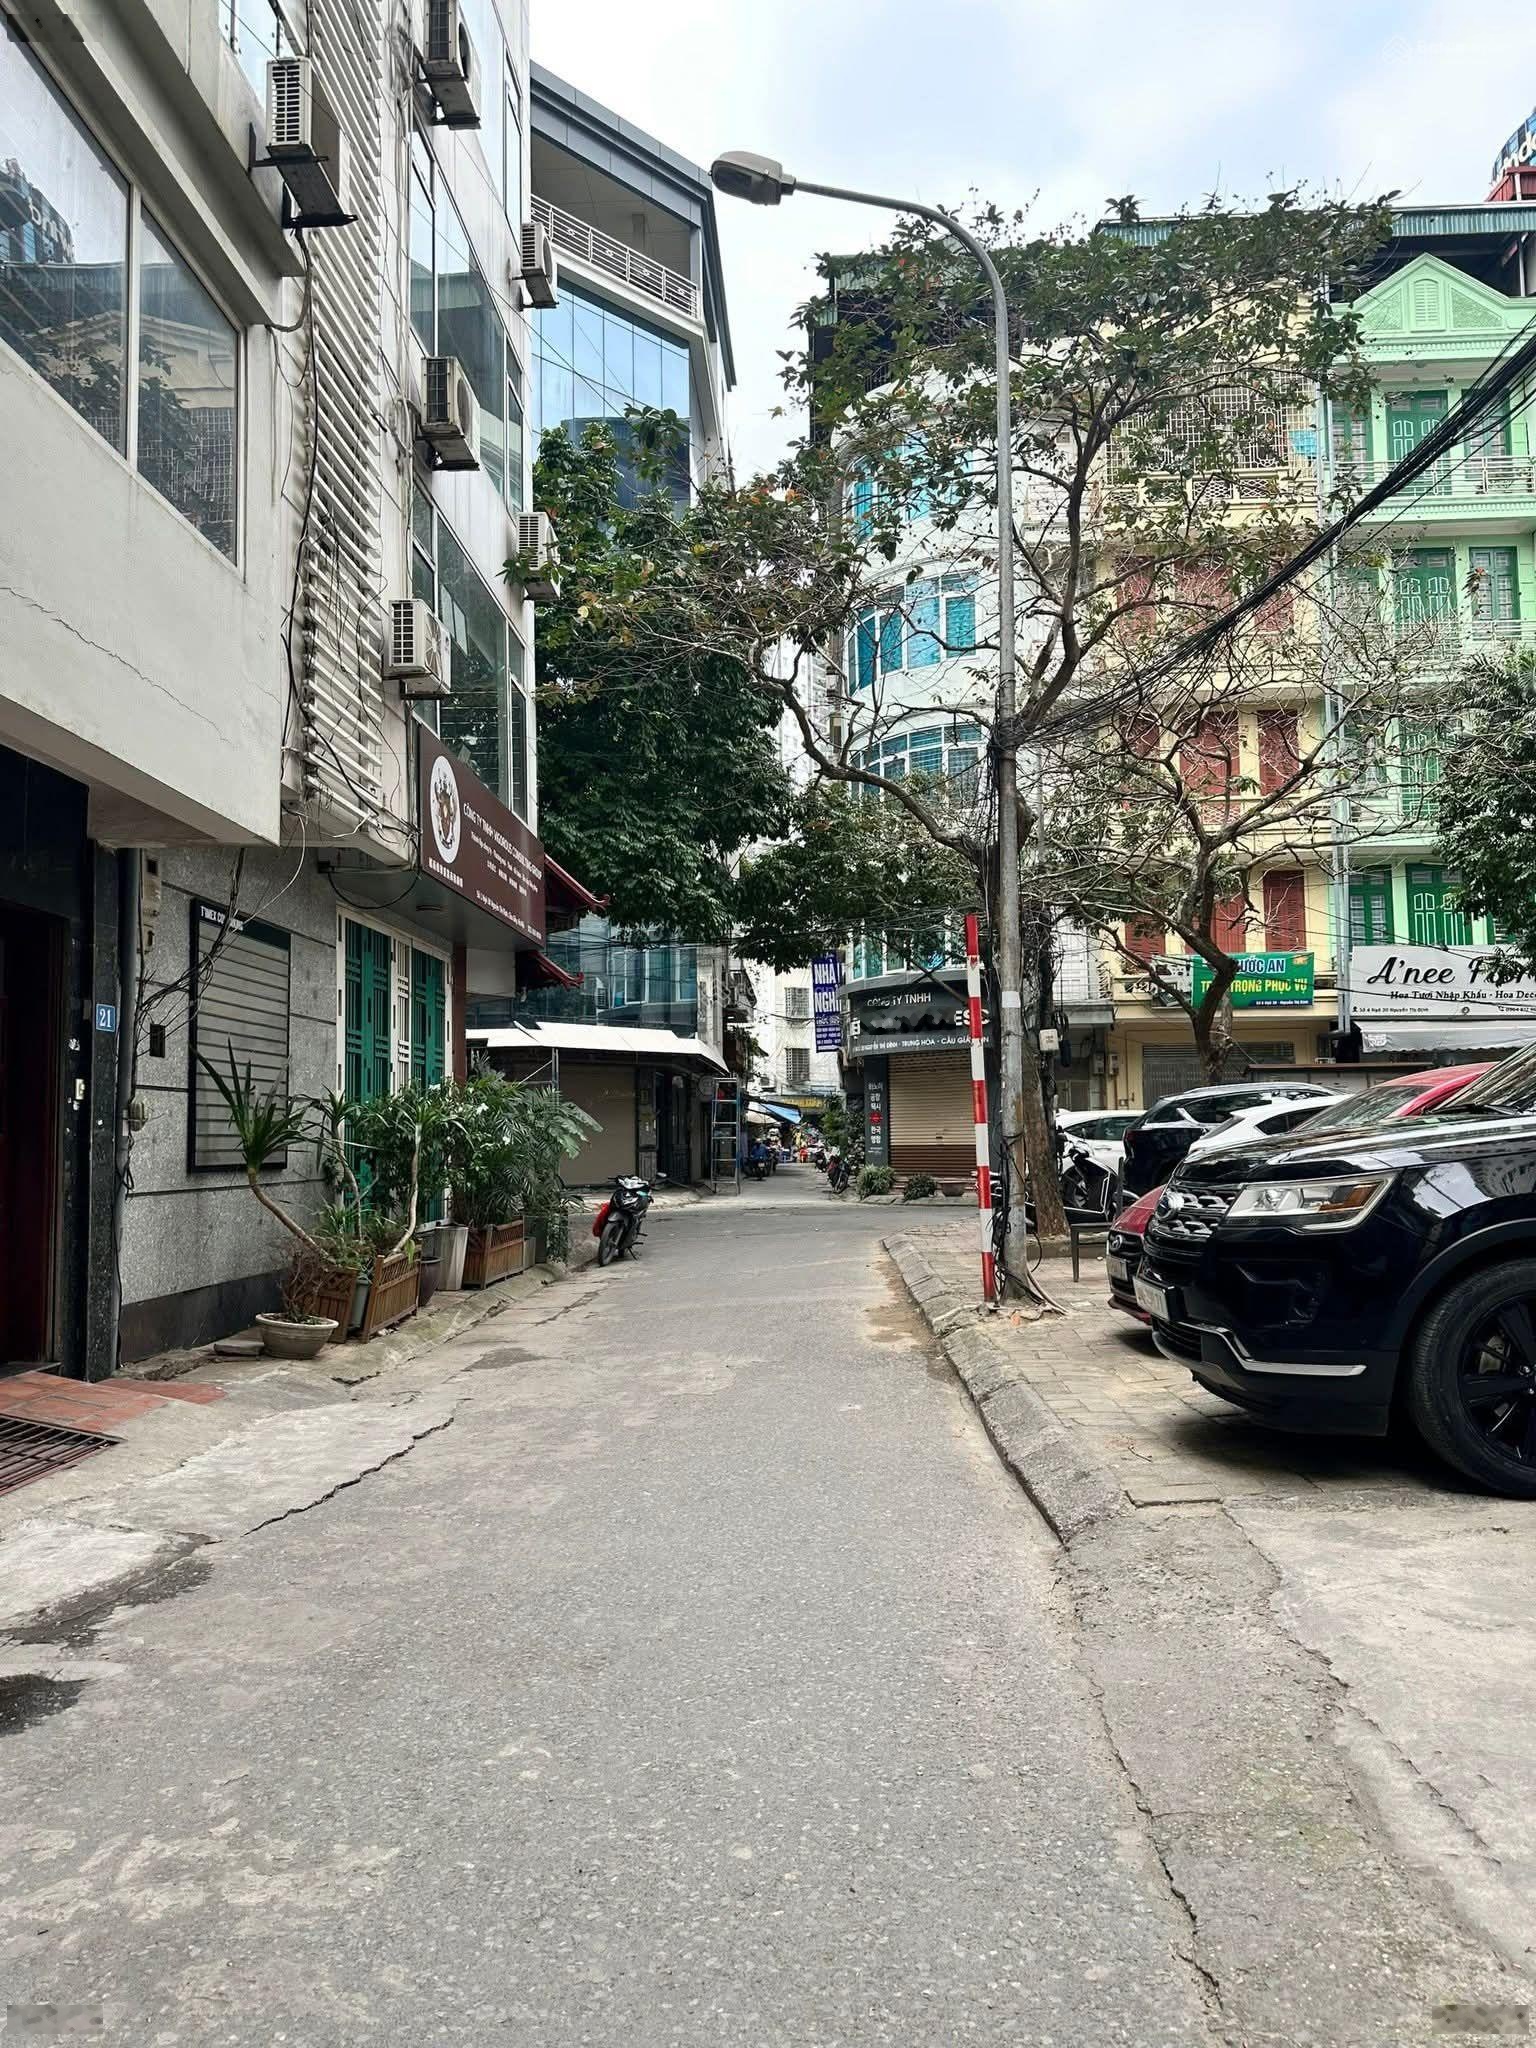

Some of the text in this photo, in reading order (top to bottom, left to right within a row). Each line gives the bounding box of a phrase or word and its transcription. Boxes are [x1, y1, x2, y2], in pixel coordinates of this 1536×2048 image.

[814, 959, 836, 984] NHÀ
[1267, 959, 1285, 973] AN
[1265, 979, 1291, 994] PHỤC
[905, 993, 931, 1003] TNHH
[1391, 991, 1408, 999] Hoa
[100, 1008, 112, 1028] 21
